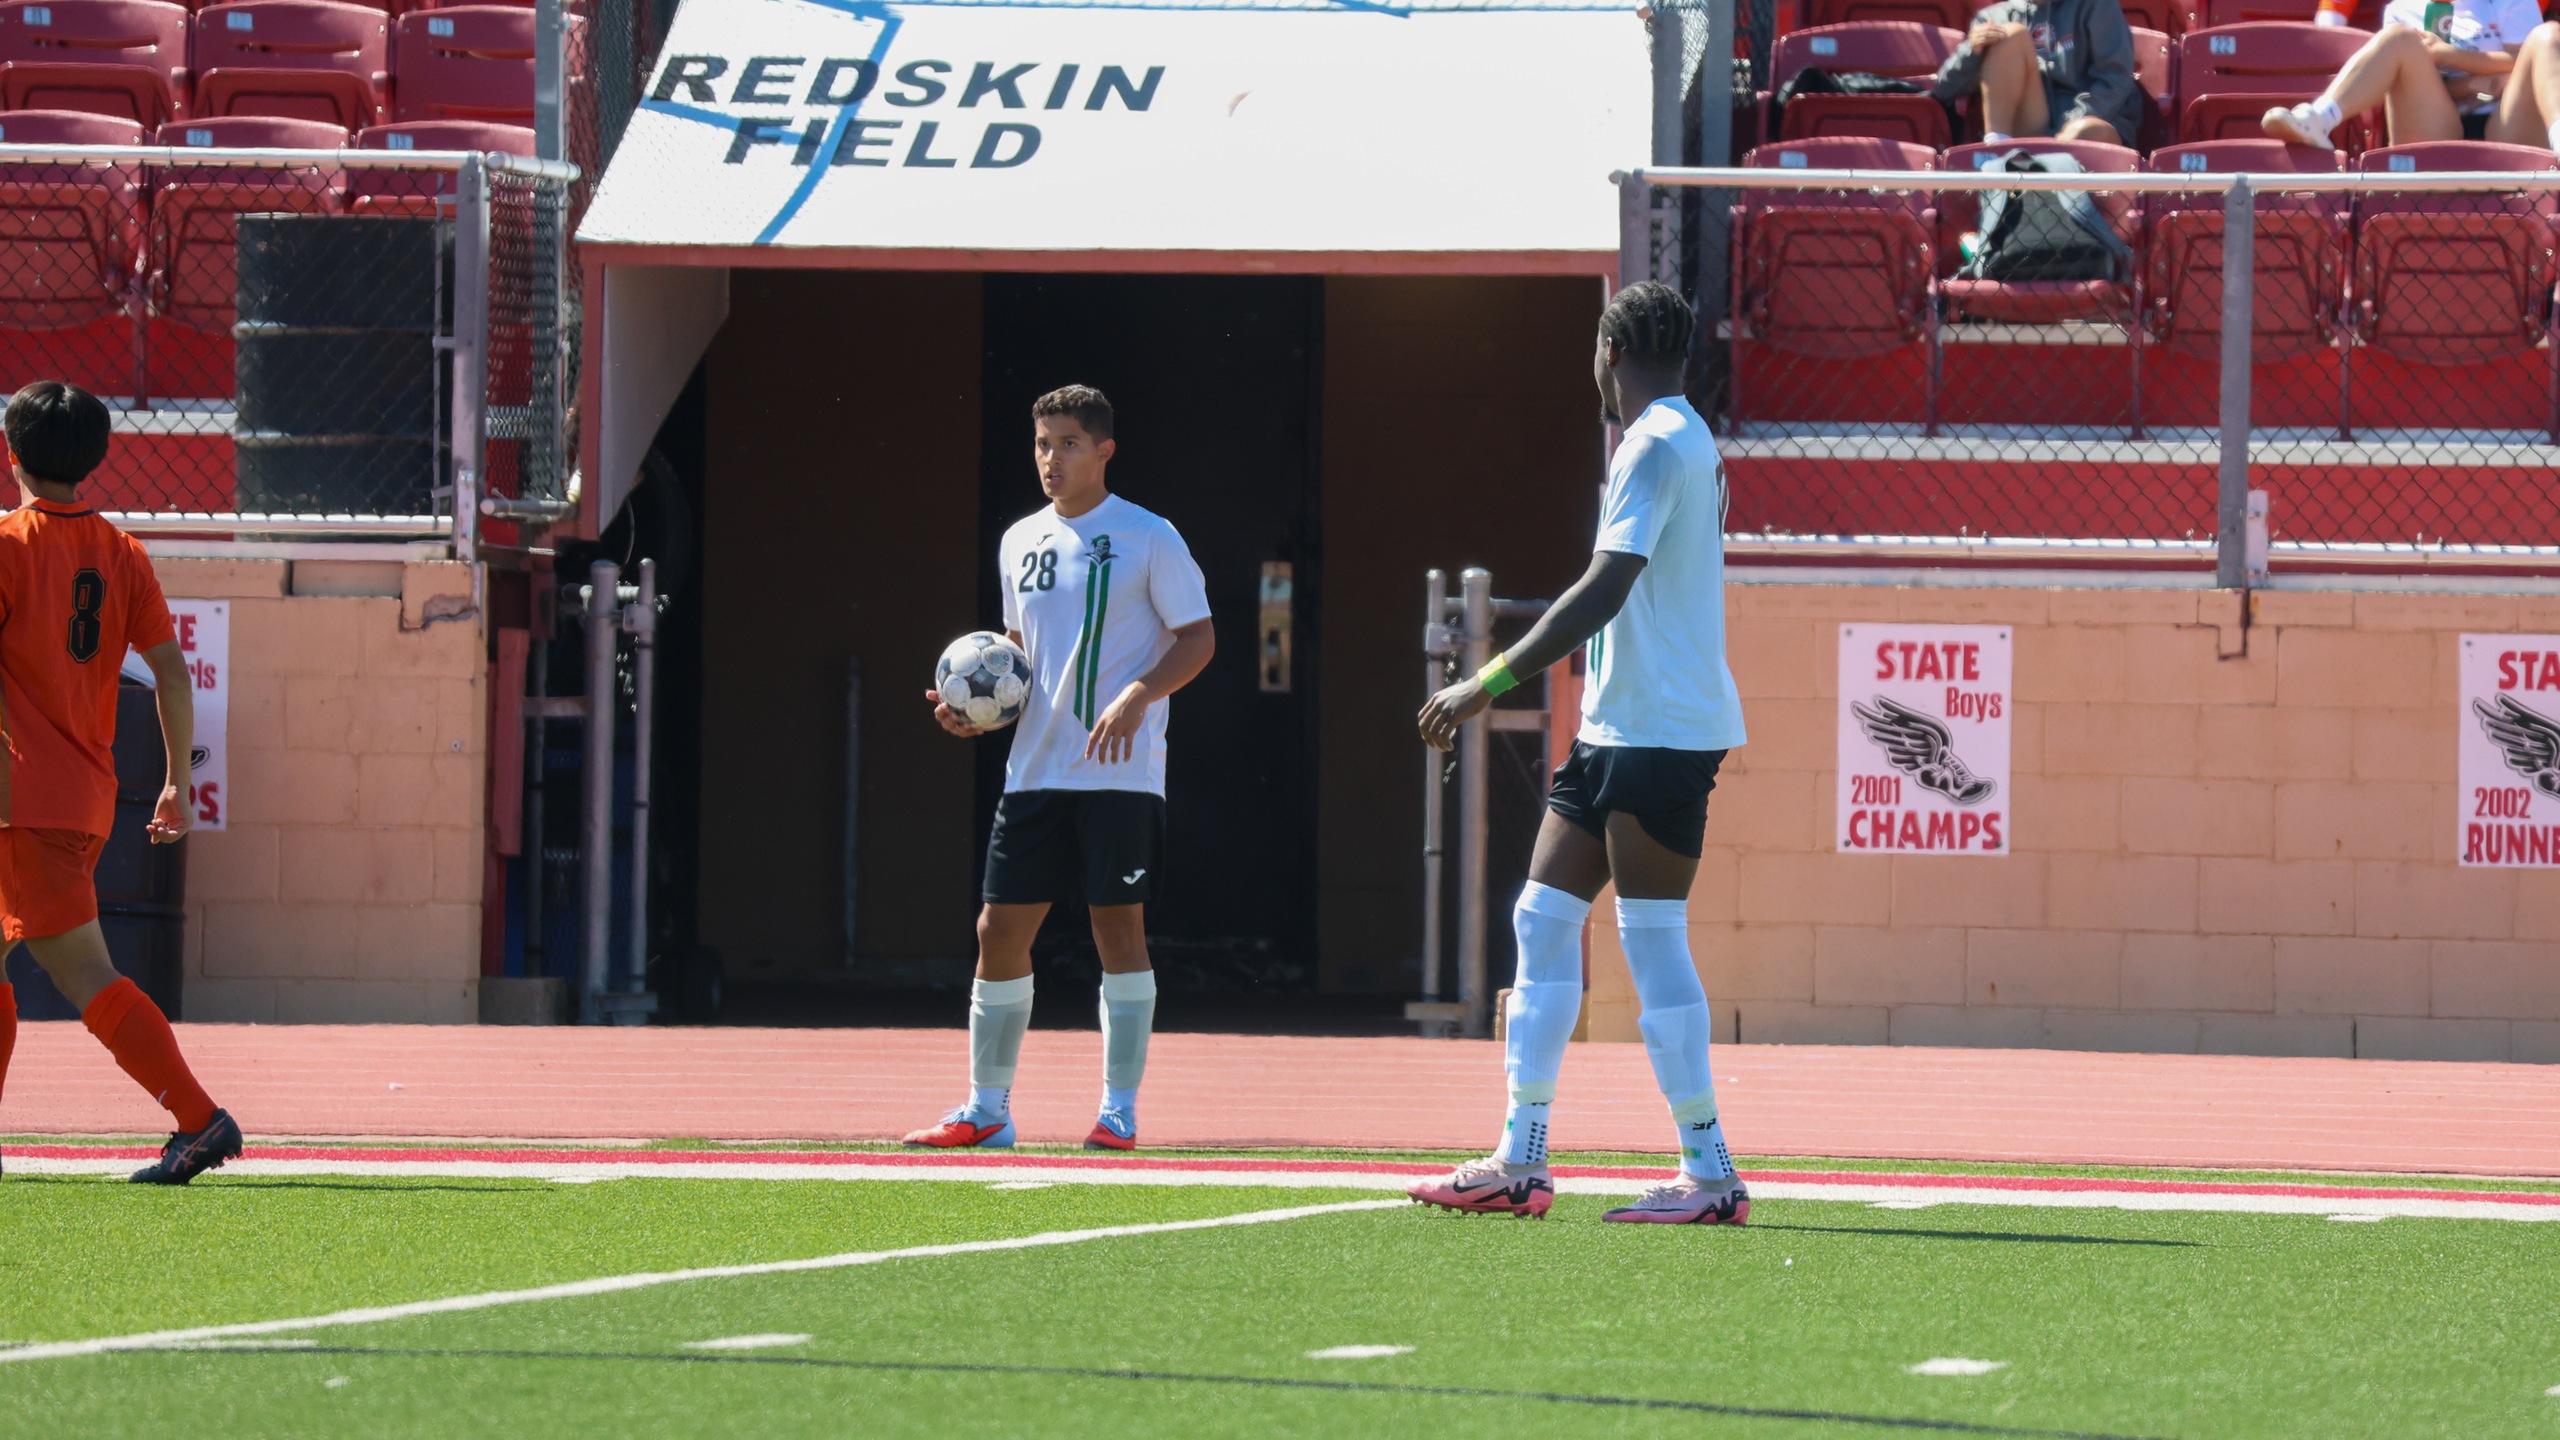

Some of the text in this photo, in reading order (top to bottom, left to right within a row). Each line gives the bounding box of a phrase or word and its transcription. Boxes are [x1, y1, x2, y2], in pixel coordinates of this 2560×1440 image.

[650, 54, 1166, 112] REDSKIN
[724, 118, 1042, 169] FIELD
[1019, 548, 1058, 593] 28
[67, 568, 107, 664] 8
[1876, 641, 1980, 681] STATE
[1945, 686, 2003, 723] Boys
[1851, 774, 1901, 805] 2001
[2475, 787, 2531, 818] 2002
[1849, 810, 2001, 850] CHAMPS
